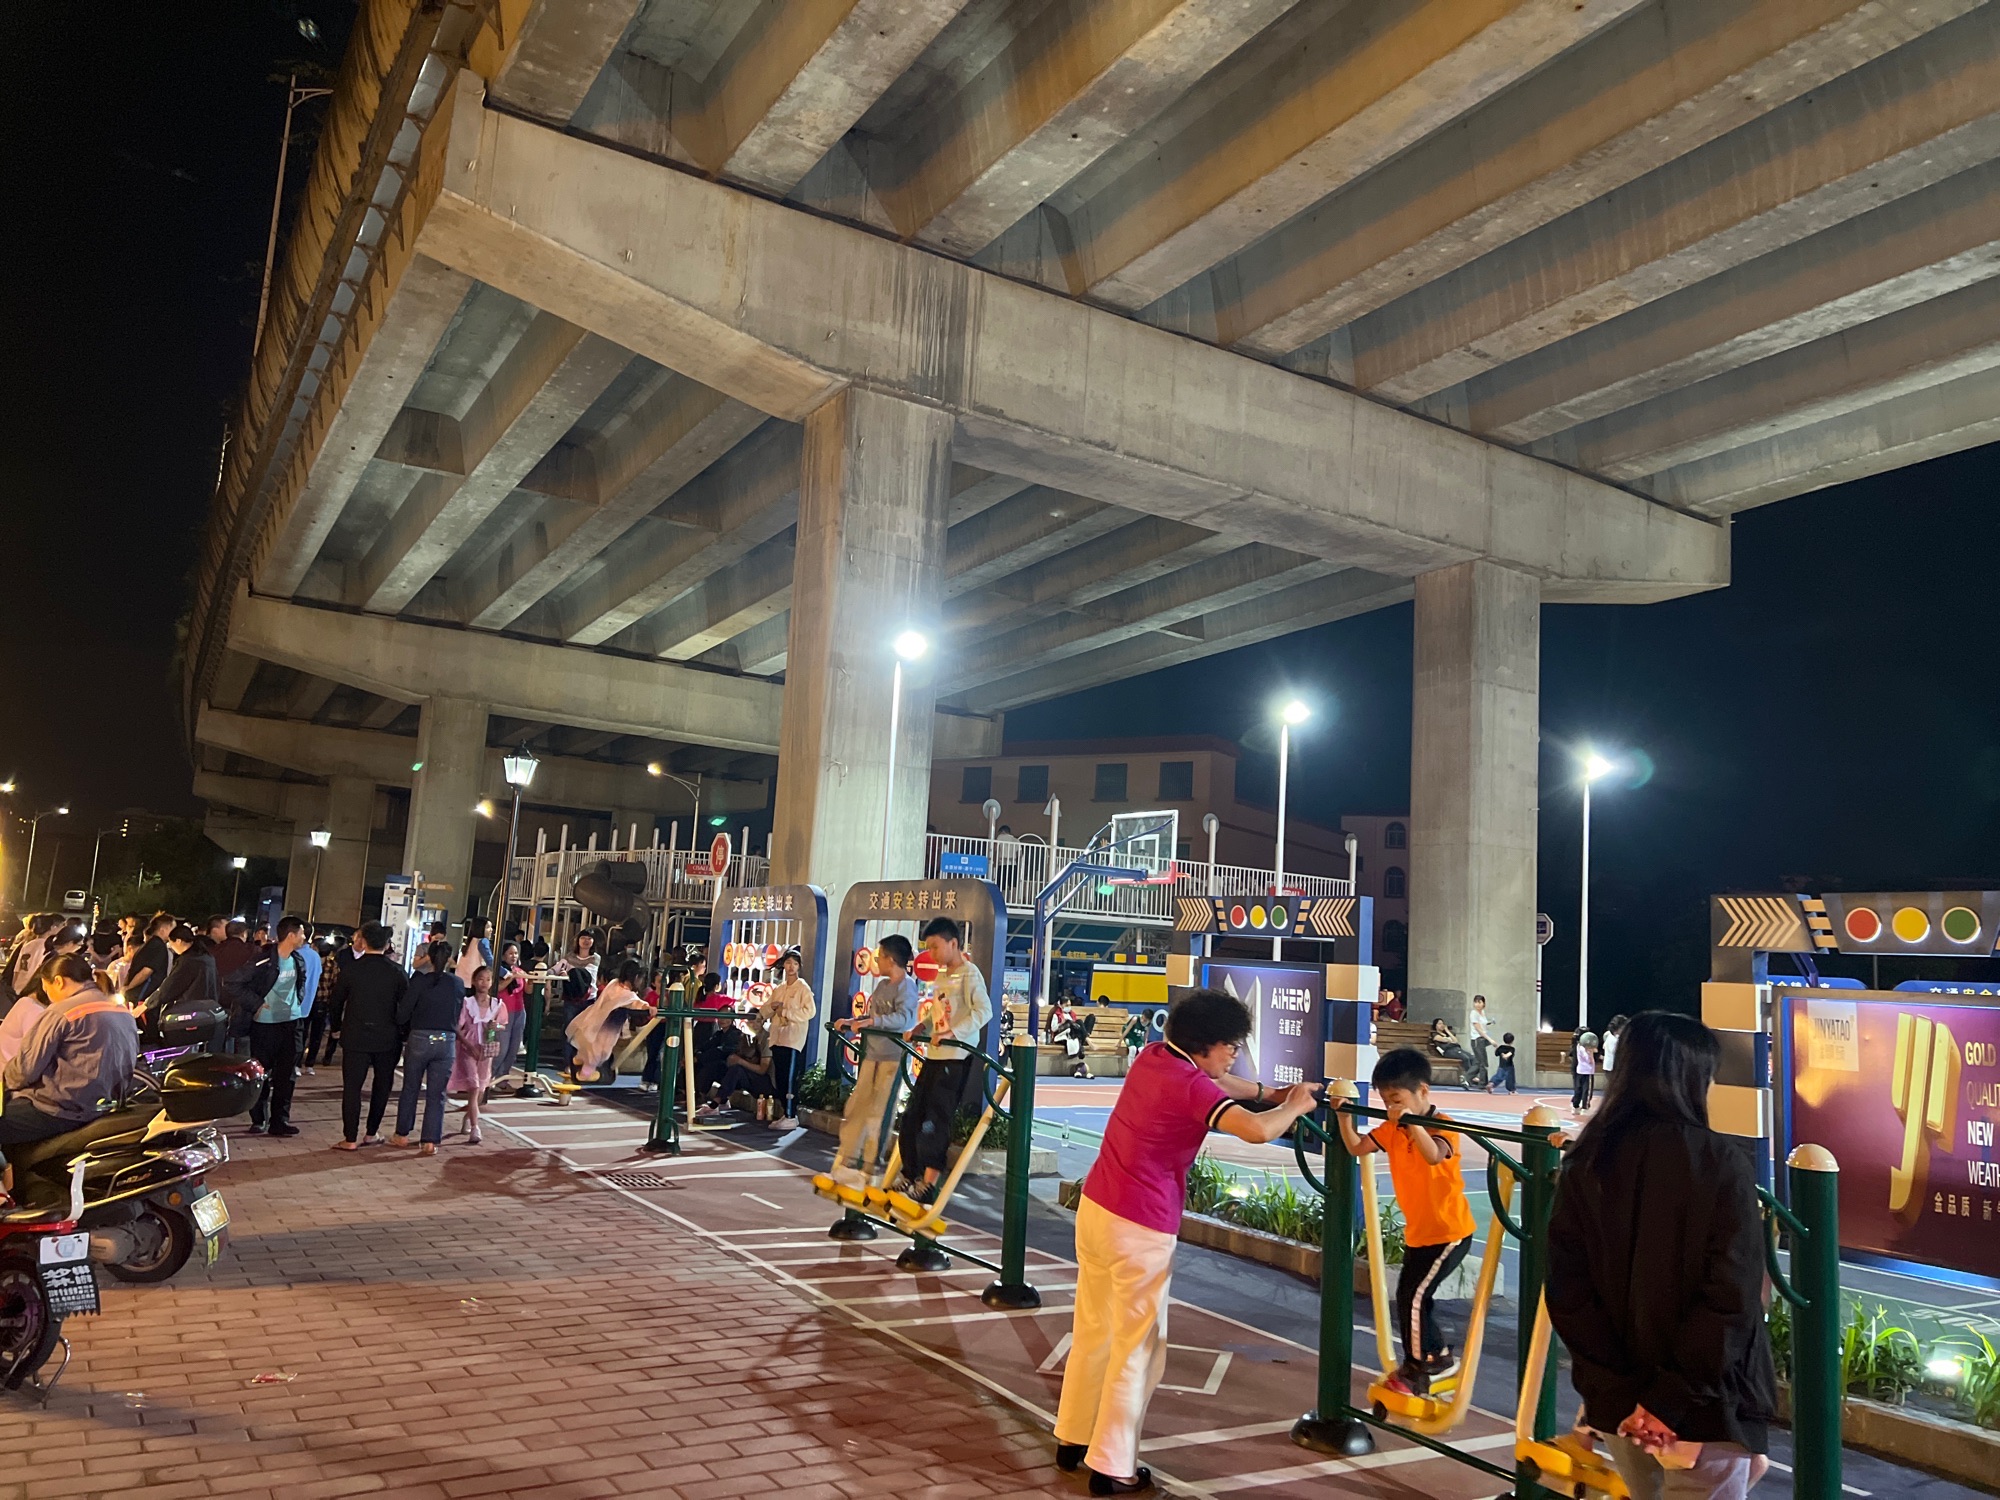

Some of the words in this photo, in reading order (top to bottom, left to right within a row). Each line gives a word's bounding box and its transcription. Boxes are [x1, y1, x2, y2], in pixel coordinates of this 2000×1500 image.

[716, 844, 725, 865] 停
[732, 893, 793, 912] 交通安全转出来
[868, 889, 956, 910] 交通安全转出来
[1965, 1041, 1997, 1067] GOLD
[1967, 1120, 1994, 1147] NEW
[1934, 1191, 1970, 1217] 金品质
